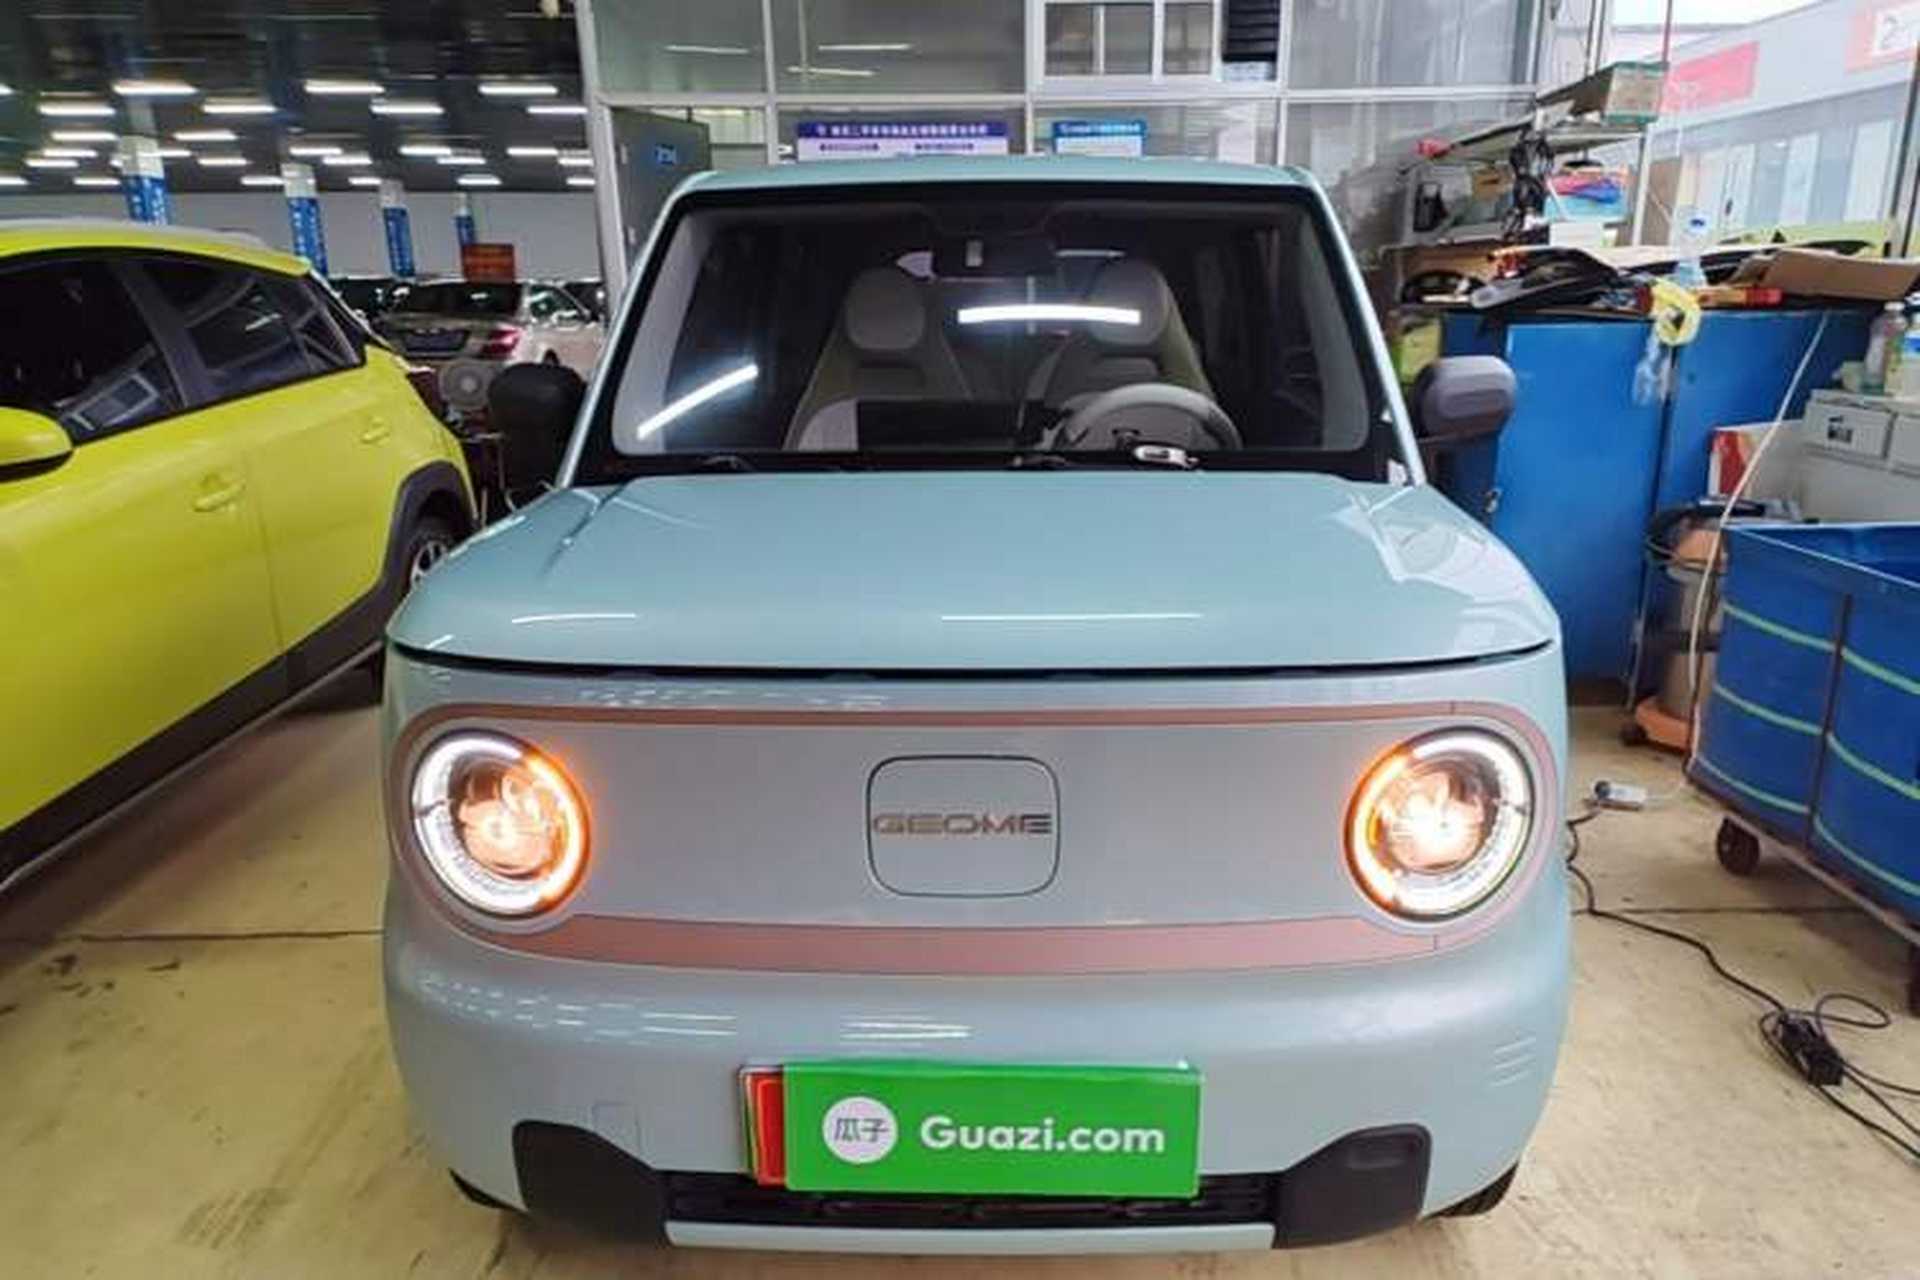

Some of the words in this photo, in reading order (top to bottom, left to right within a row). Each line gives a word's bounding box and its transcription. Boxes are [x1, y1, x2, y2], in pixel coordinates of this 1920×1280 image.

[874, 813, 1052, 835] GEOME
[834, 1117, 889, 1143] 瓜子
[920, 1114, 1165, 1154] Guazi.com
